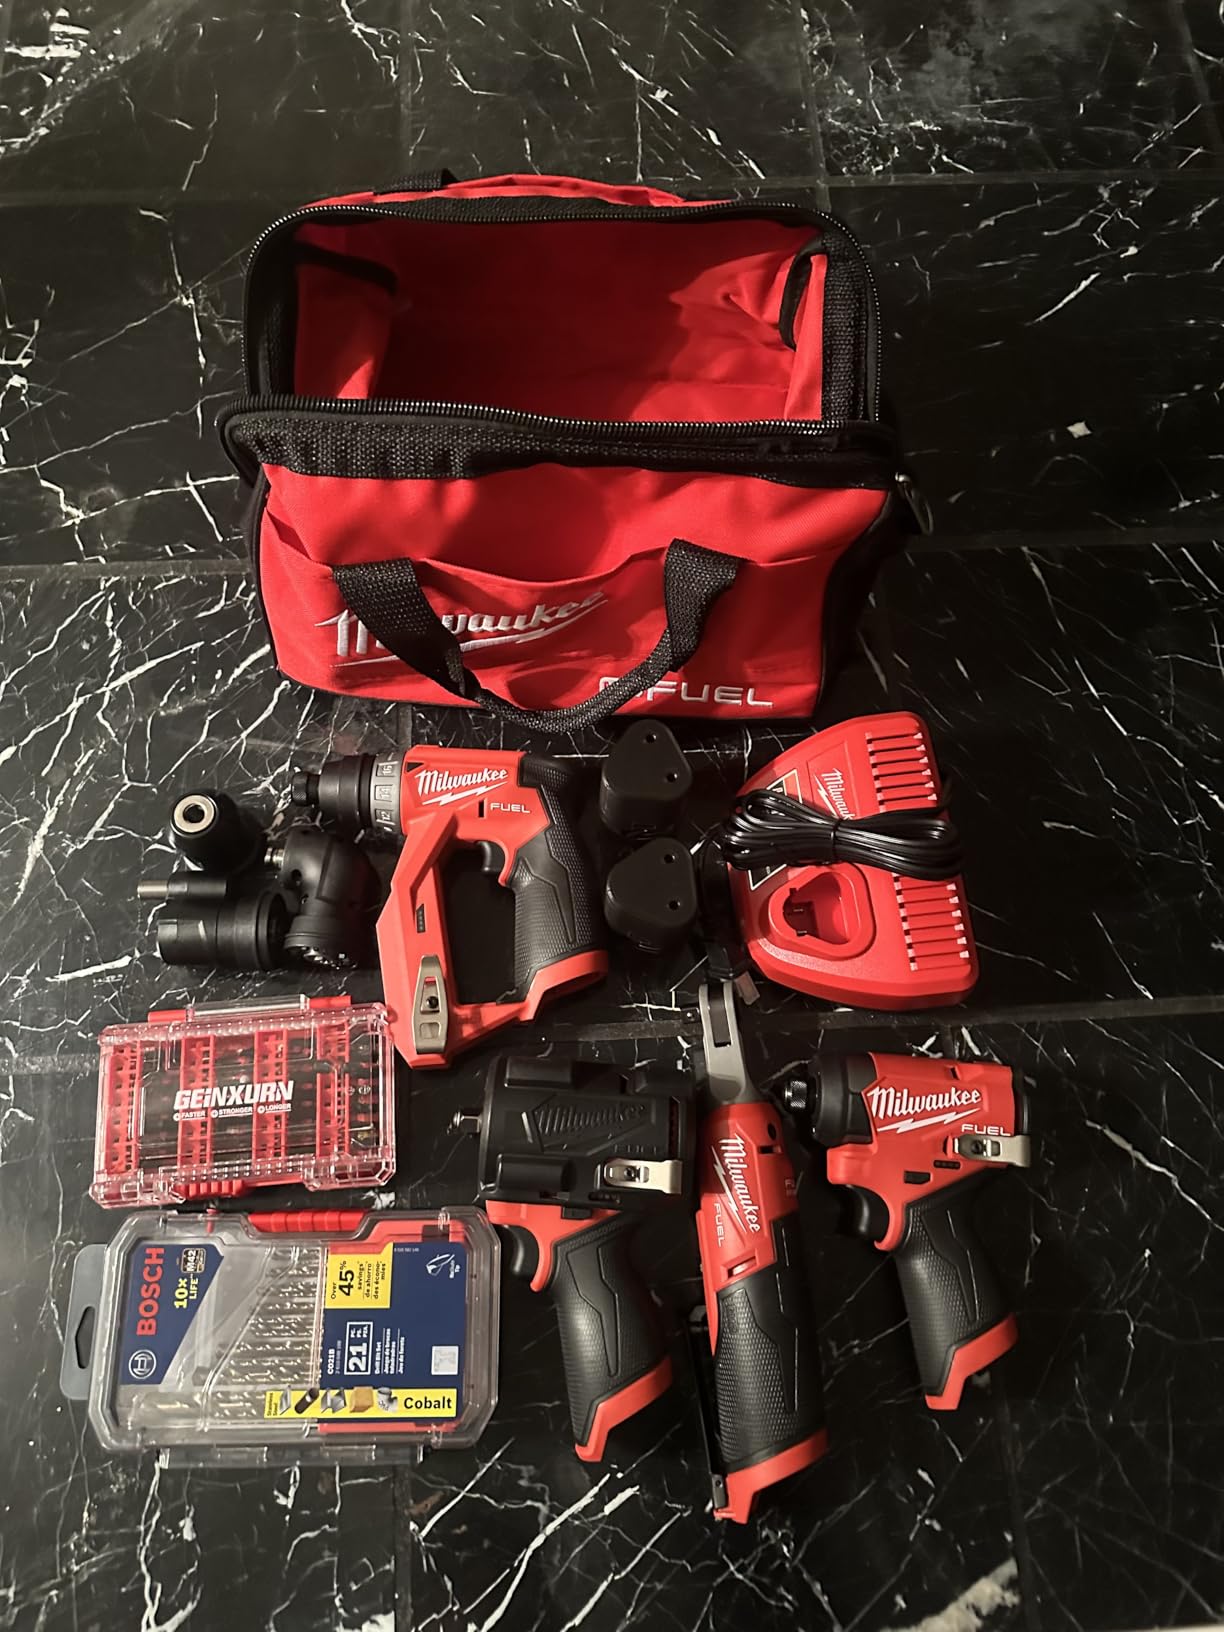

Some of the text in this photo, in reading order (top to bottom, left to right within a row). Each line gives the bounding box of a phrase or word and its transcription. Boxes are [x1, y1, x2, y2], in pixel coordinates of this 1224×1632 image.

[646, 680, 773, 708] FUEL
[415, 767, 508, 797] Milwaukee
[490, 802, 531, 814] FUEL
[180, 1102, 292, 1120] FASTER STRONGER LONGER
[867, 1085, 982, 1120] Milwaukee
[961, 1123, 1011, 1137] FUEL
[718, 1132, 761, 1234] Milwaukee
[713, 1202, 725, 1247] FUEL
[186, 1250, 197, 1272] M42
[136, 1247, 165, 1336] BOSCH
[348, 1342, 368, 1372] 21
[404, 1396, 452, 1410] Cobalt
